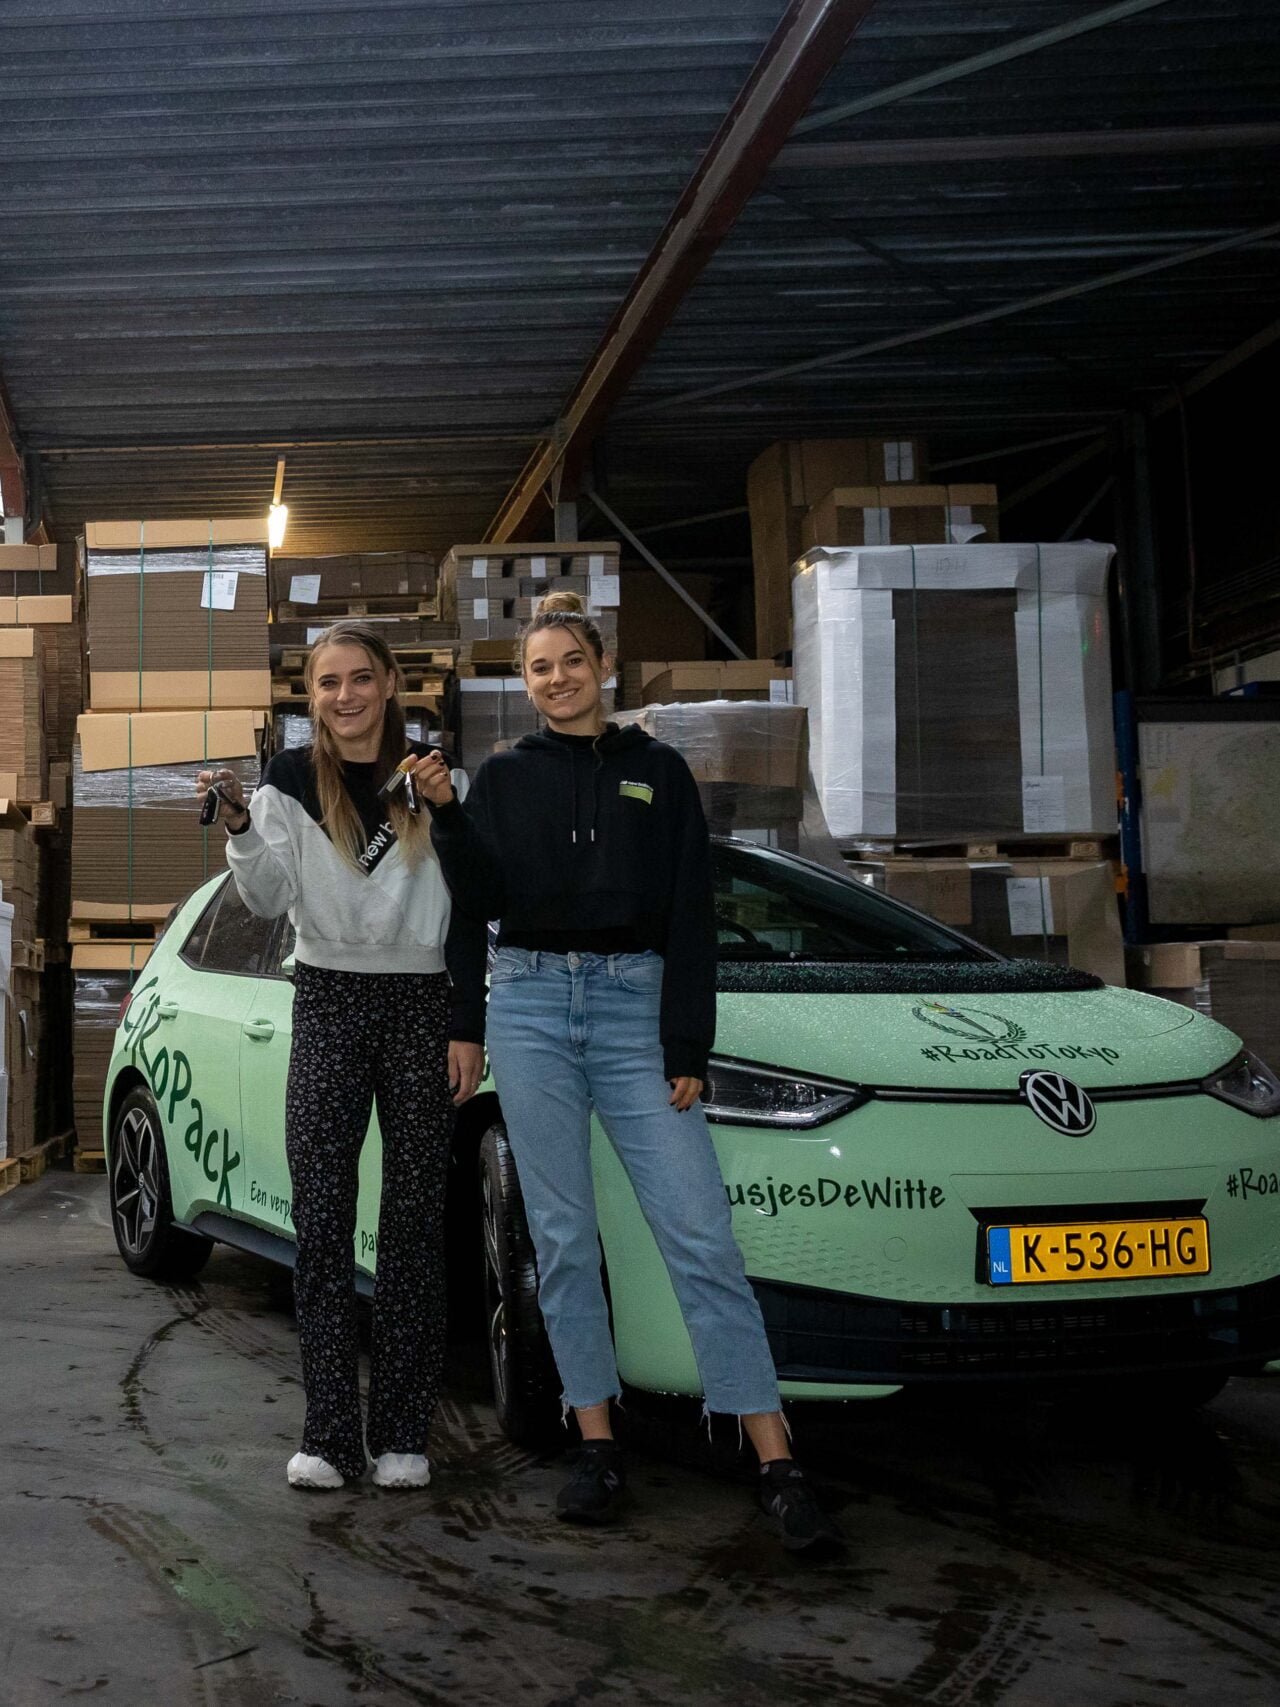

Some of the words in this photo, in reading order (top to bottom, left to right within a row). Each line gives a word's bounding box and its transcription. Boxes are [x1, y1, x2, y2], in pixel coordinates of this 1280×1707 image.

[359, 831, 387, 866] new
[920, 1043, 1120, 1065] #RoadToTokyo
[250, 1180, 267, 1207] Een
[993, 1262, 1009, 1273] NL
[1023, 1226, 1198, 1274] K-536-HG
